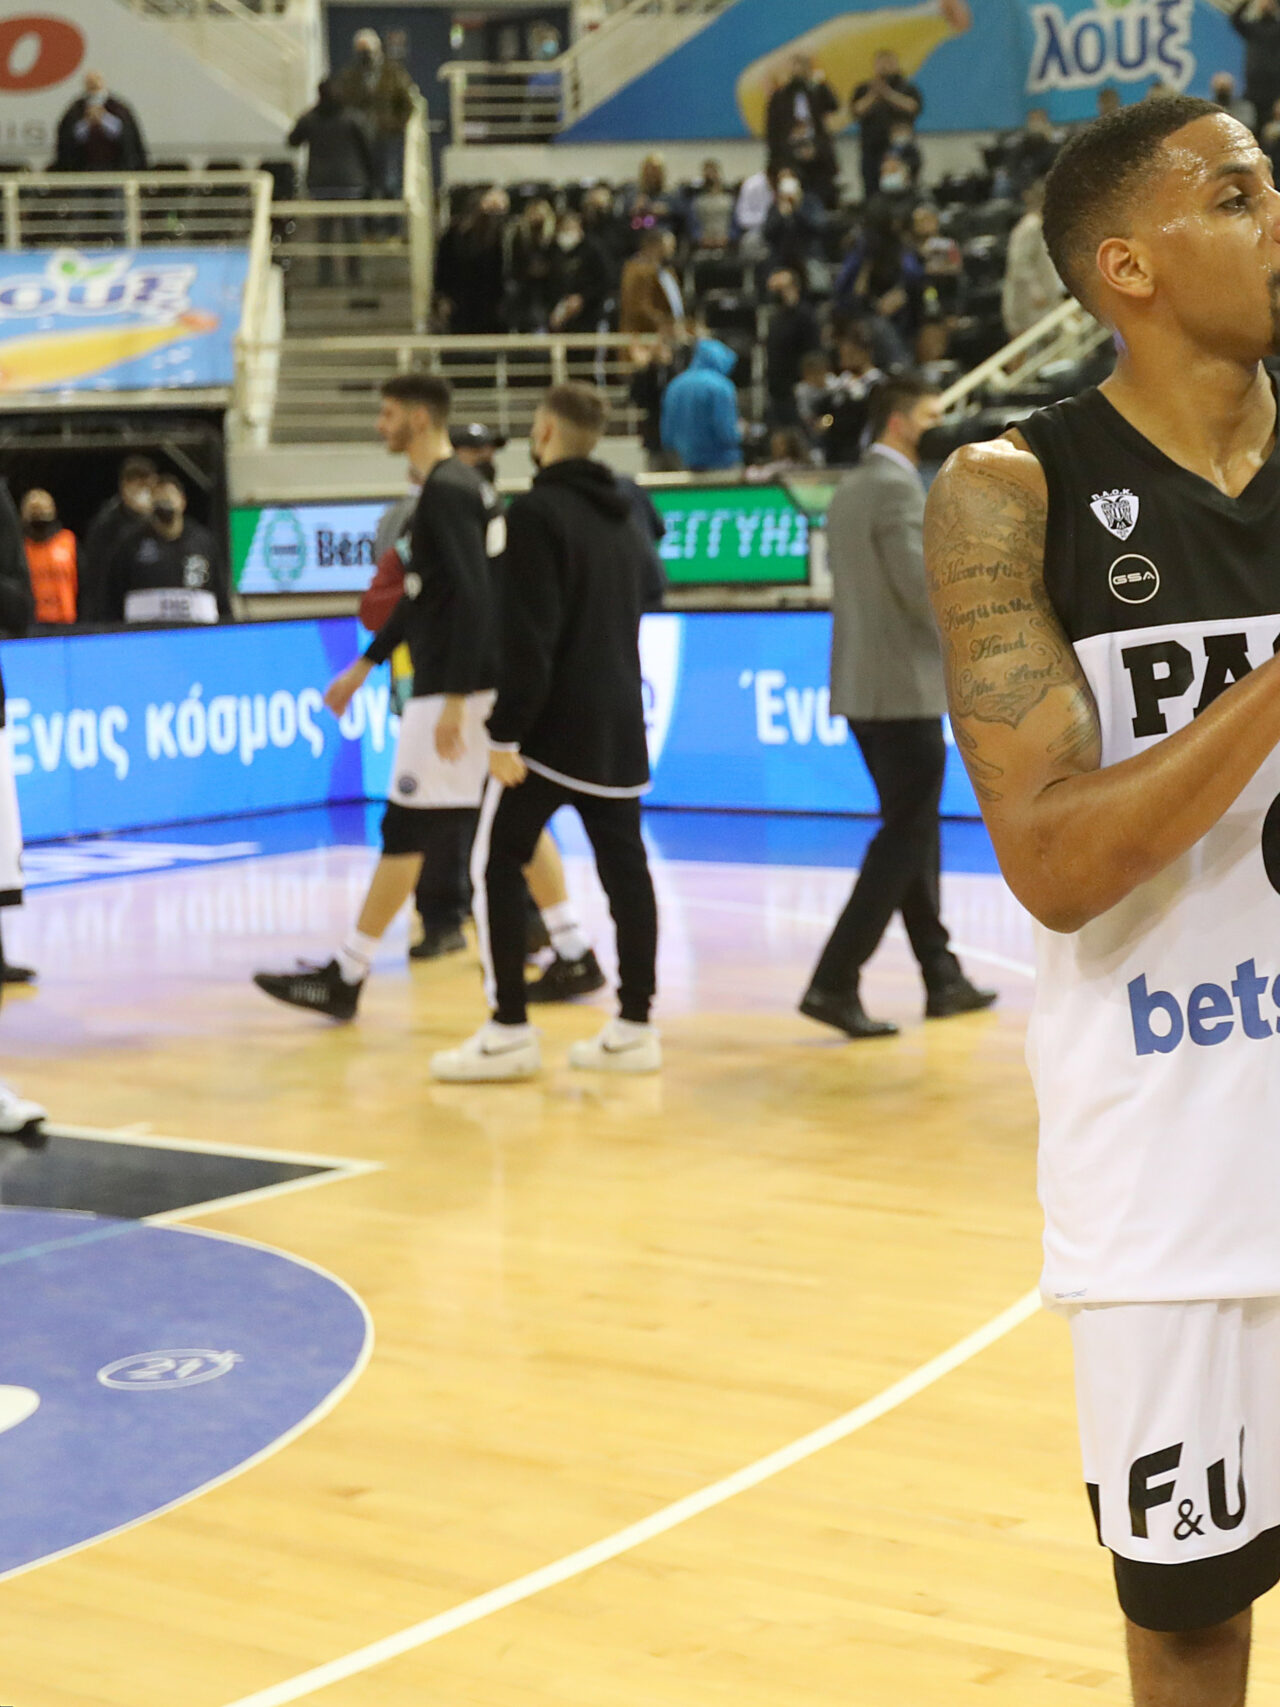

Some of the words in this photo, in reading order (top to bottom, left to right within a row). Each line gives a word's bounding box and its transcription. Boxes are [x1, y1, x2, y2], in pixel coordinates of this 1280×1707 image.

[1112, 570, 1156, 586] GSA
[969, 631, 1026, 662] Hand
[145, 682, 325, 758] κόσμος
[738, 669, 848, 746] Ένα
[1128, 1424, 1247, 1541] F&U
